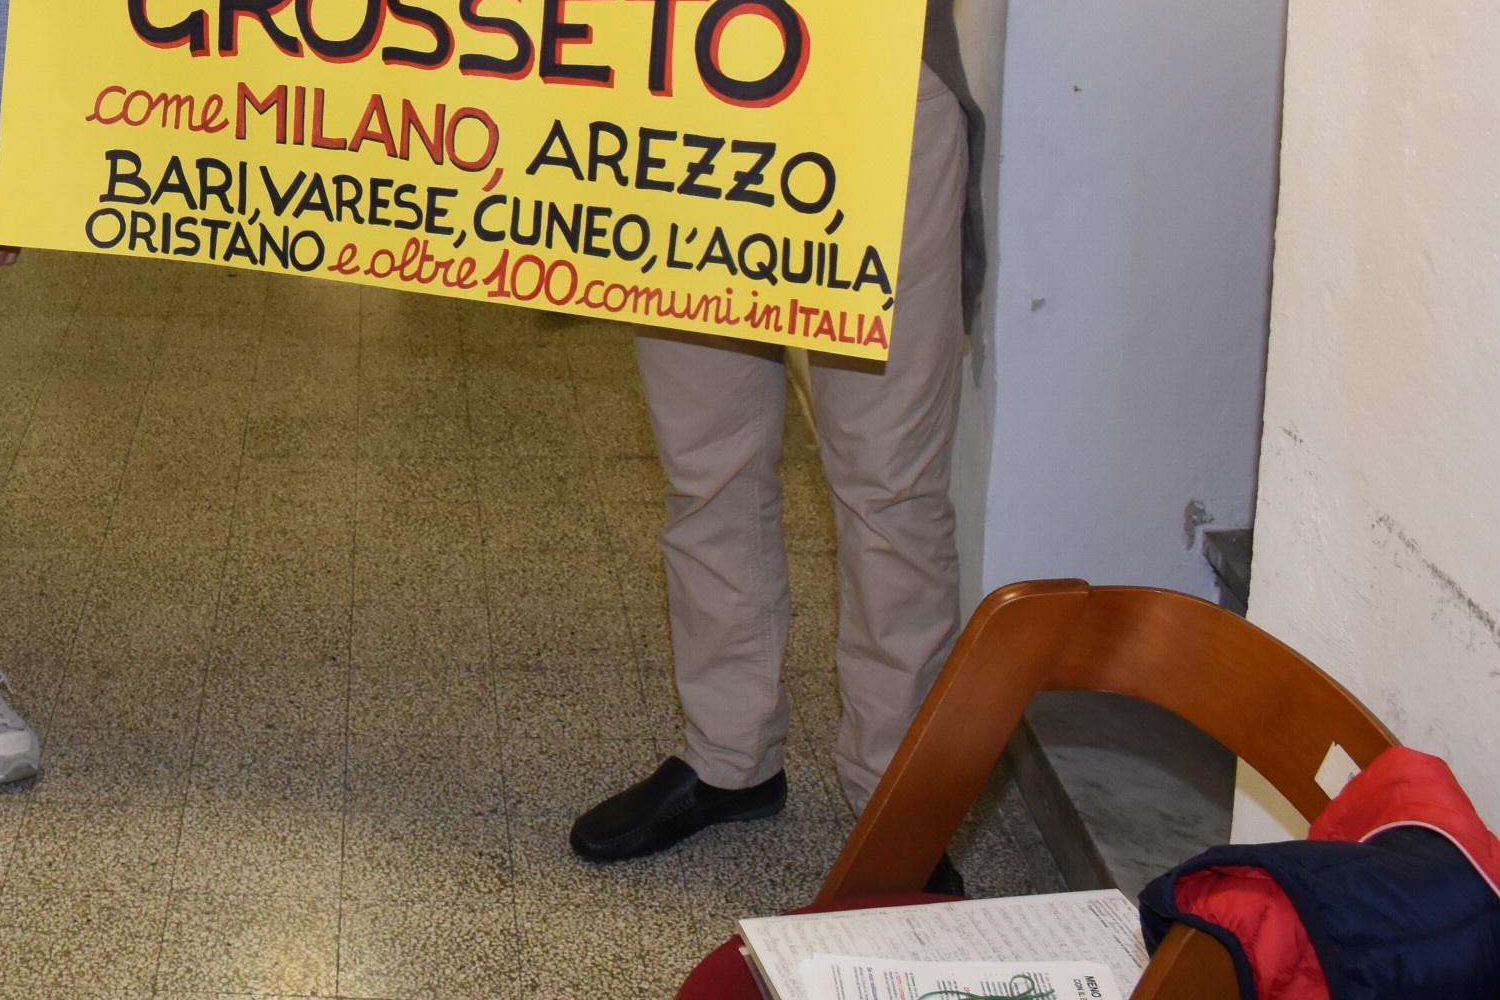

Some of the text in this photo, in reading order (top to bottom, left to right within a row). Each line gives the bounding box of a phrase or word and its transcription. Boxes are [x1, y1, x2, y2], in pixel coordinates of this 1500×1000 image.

[84, 81, 845, 236] come MILANO, AREZZO,
[98, 149, 896, 310] BARI, VARESE, CUNEO, L'AQUILA,
[85, 207, 889, 350] ORISTANO e oltre 100 comuni in ITALIA
